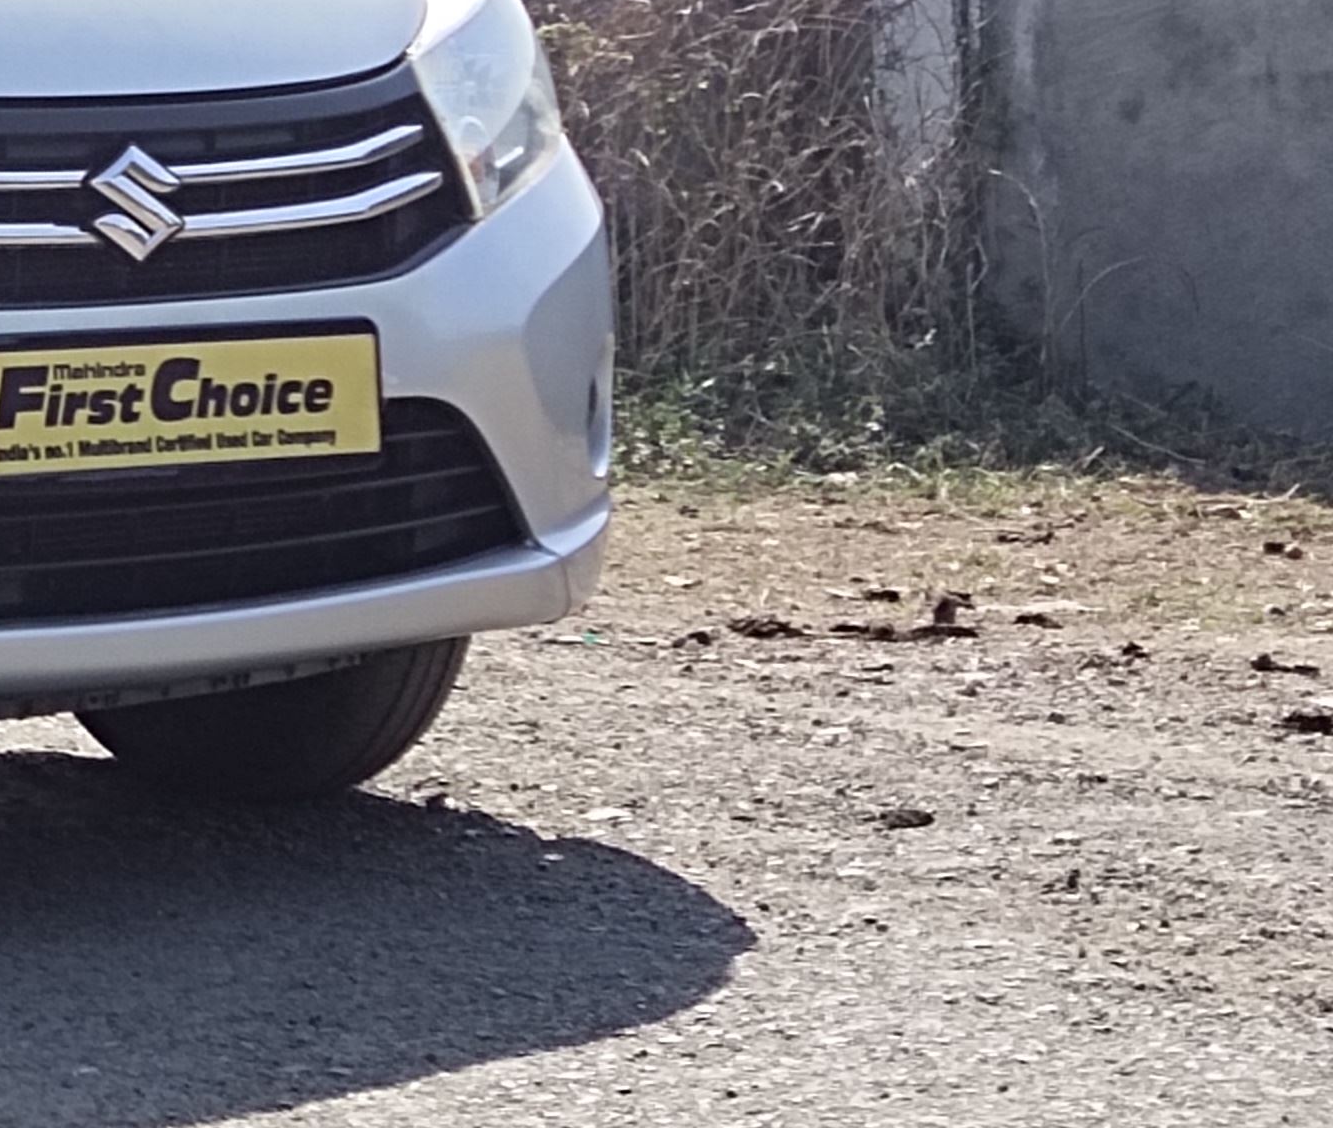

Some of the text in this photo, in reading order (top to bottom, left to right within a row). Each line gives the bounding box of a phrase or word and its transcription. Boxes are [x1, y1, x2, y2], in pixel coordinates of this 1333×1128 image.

[52, 362, 147, 381] Mahindra
[77, 435, 153, 457] Multibrand
[155, 433, 213, 453] Certified
[215, 430, 248, 449] Used
[251, 430, 274, 448] Car
[276, 428, 337, 448] Company
